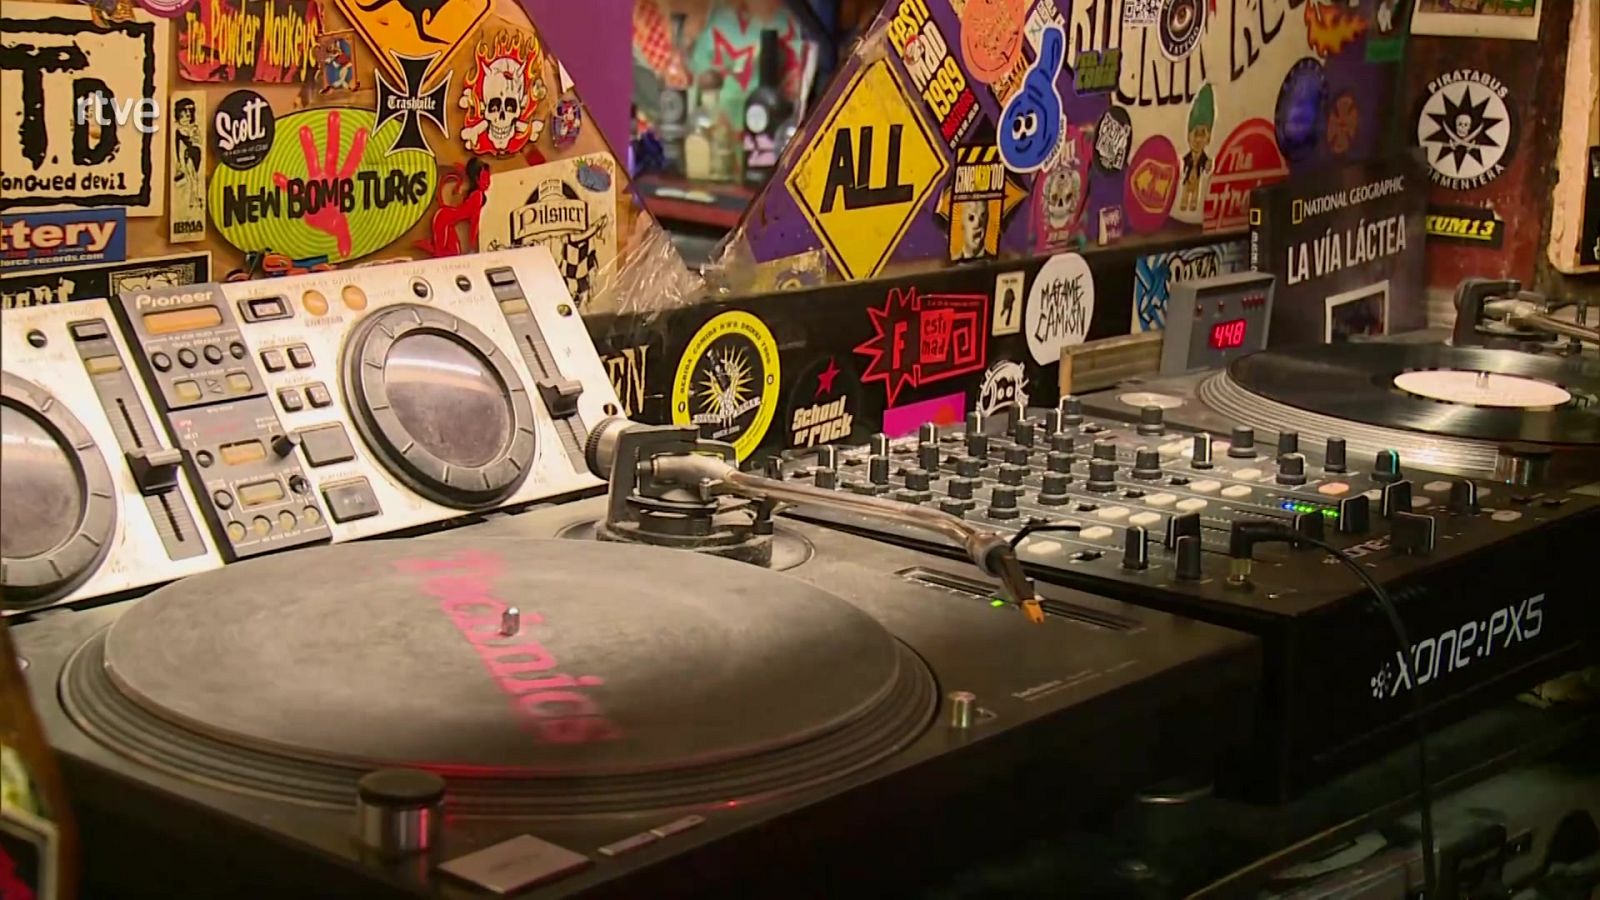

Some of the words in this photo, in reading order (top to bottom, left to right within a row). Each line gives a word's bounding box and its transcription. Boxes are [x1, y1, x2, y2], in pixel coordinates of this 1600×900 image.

[186, 12, 206, 65] The
[211, 0, 260, 68] Powder
[263, 0, 320, 82] Monkeys
[1168, 26, 1199, 55] TATTOO
[922, 55, 966, 123] 1999
[1427, 69, 1509, 98] PIRATABUS
[216, 98, 268, 151] Scott
[0, 171, 76, 192] ongued
[81, 172, 127, 191] devil
[820, 124, 914, 214] ALL
[1428, 163, 1505, 190] RMENTERA
[287, 176, 355, 219] BOMB
[357, 169, 428, 211] TURKS
[1303, 191, 1348, 218] NATIONAL
[1349, 175, 1404, 205] GEOGRAPHIC
[517, 204, 584, 235] Pilsner
[1288, 242, 1309, 285] LA
[1314, 227, 1342, 277] VÍA
[1346, 214, 1407, 267] LÁCTEA
[135, 291, 213, 310] Pioneer
[892, 322, 908, 370] F
[1214, 321, 1245, 348] 448
[601, 344, 650, 417] EN
[792, 394, 847, 431] School
